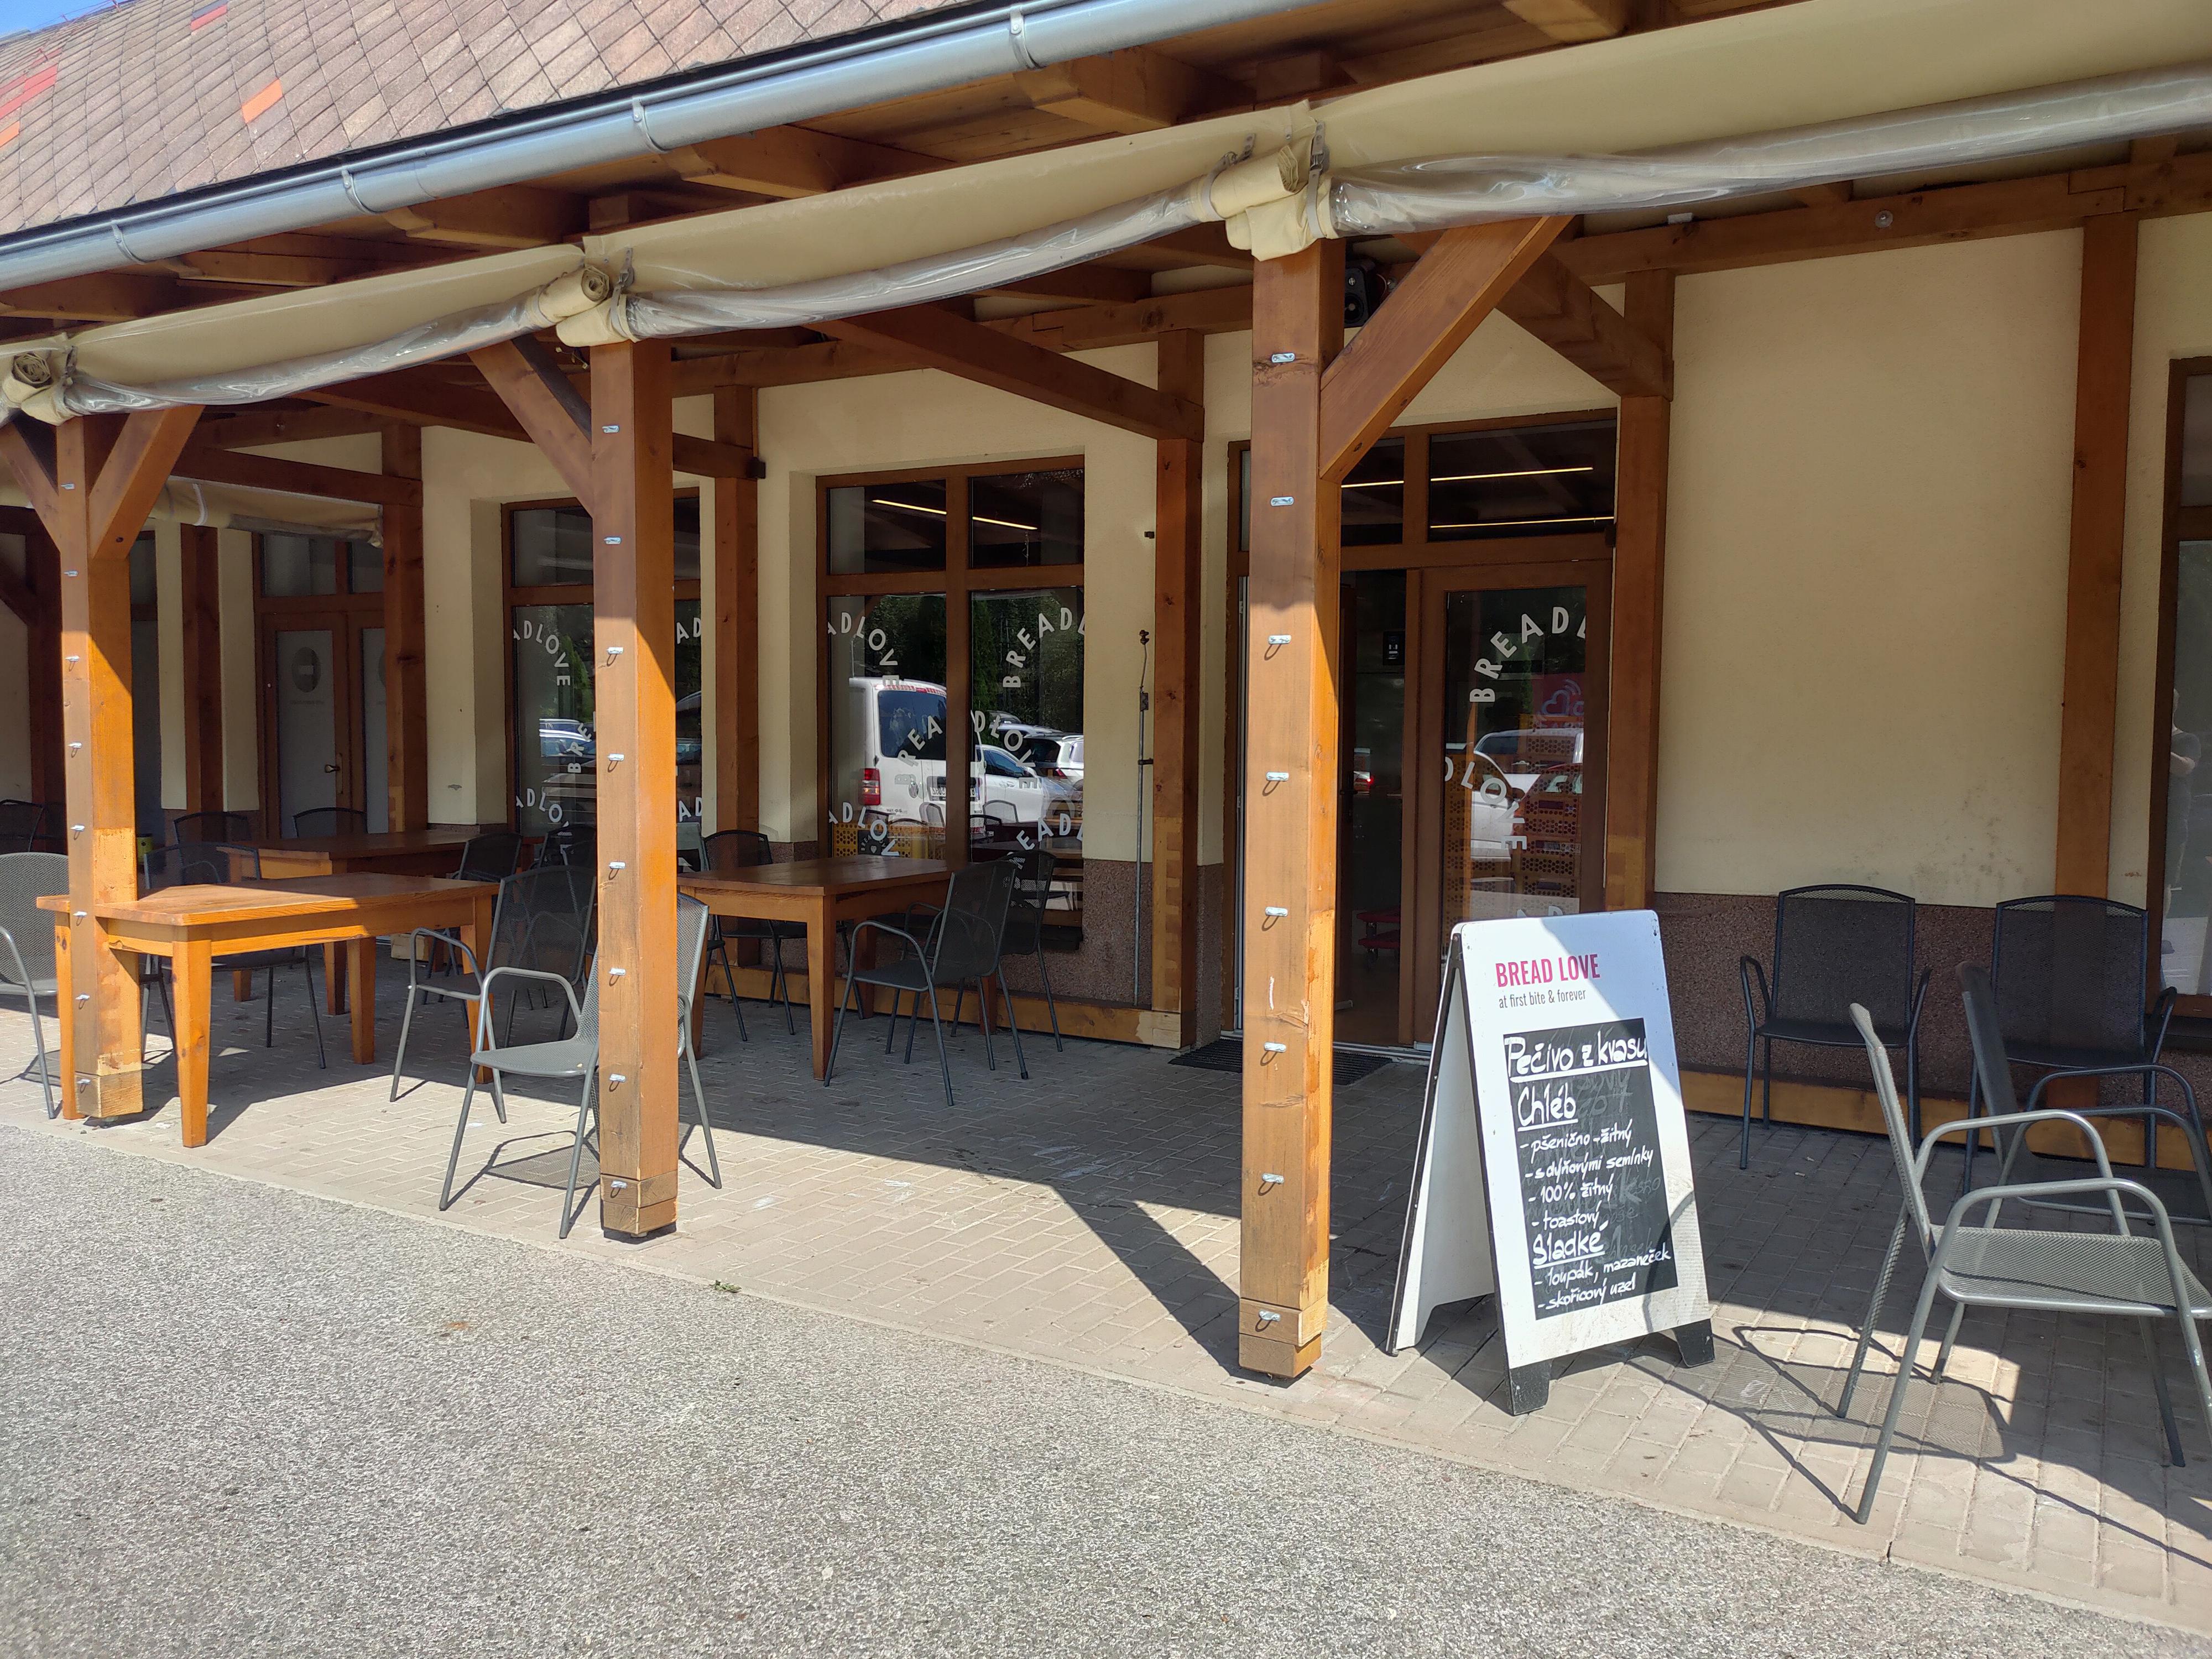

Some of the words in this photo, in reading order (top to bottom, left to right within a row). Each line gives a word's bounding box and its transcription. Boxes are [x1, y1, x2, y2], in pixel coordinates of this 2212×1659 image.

[1495, 959, 1553, 987] BREAD
[1558, 954, 1600, 981] LOVE
[1499, 995, 1507, 1008] at
[1510, 994, 1529, 1008] first
[1529, 992, 1545, 1005] bite
[1548, 990, 1554, 1003] &
[1557, 989, 1586, 1003] forever
[1504, 1036, 1573, 1077] Pečivo
[1598, 1030, 1647, 1065] kvasu
[1517, 1082, 1576, 1126] Chléb
[1541, 1182, 1575, 1203] 100%
[1580, 1173, 1614, 1201] žitný
[1543, 1201, 1602, 1230] toastový
[1532, 1220, 1609, 1265] Sladké
[1610, 1272, 1636, 1295] uzel
